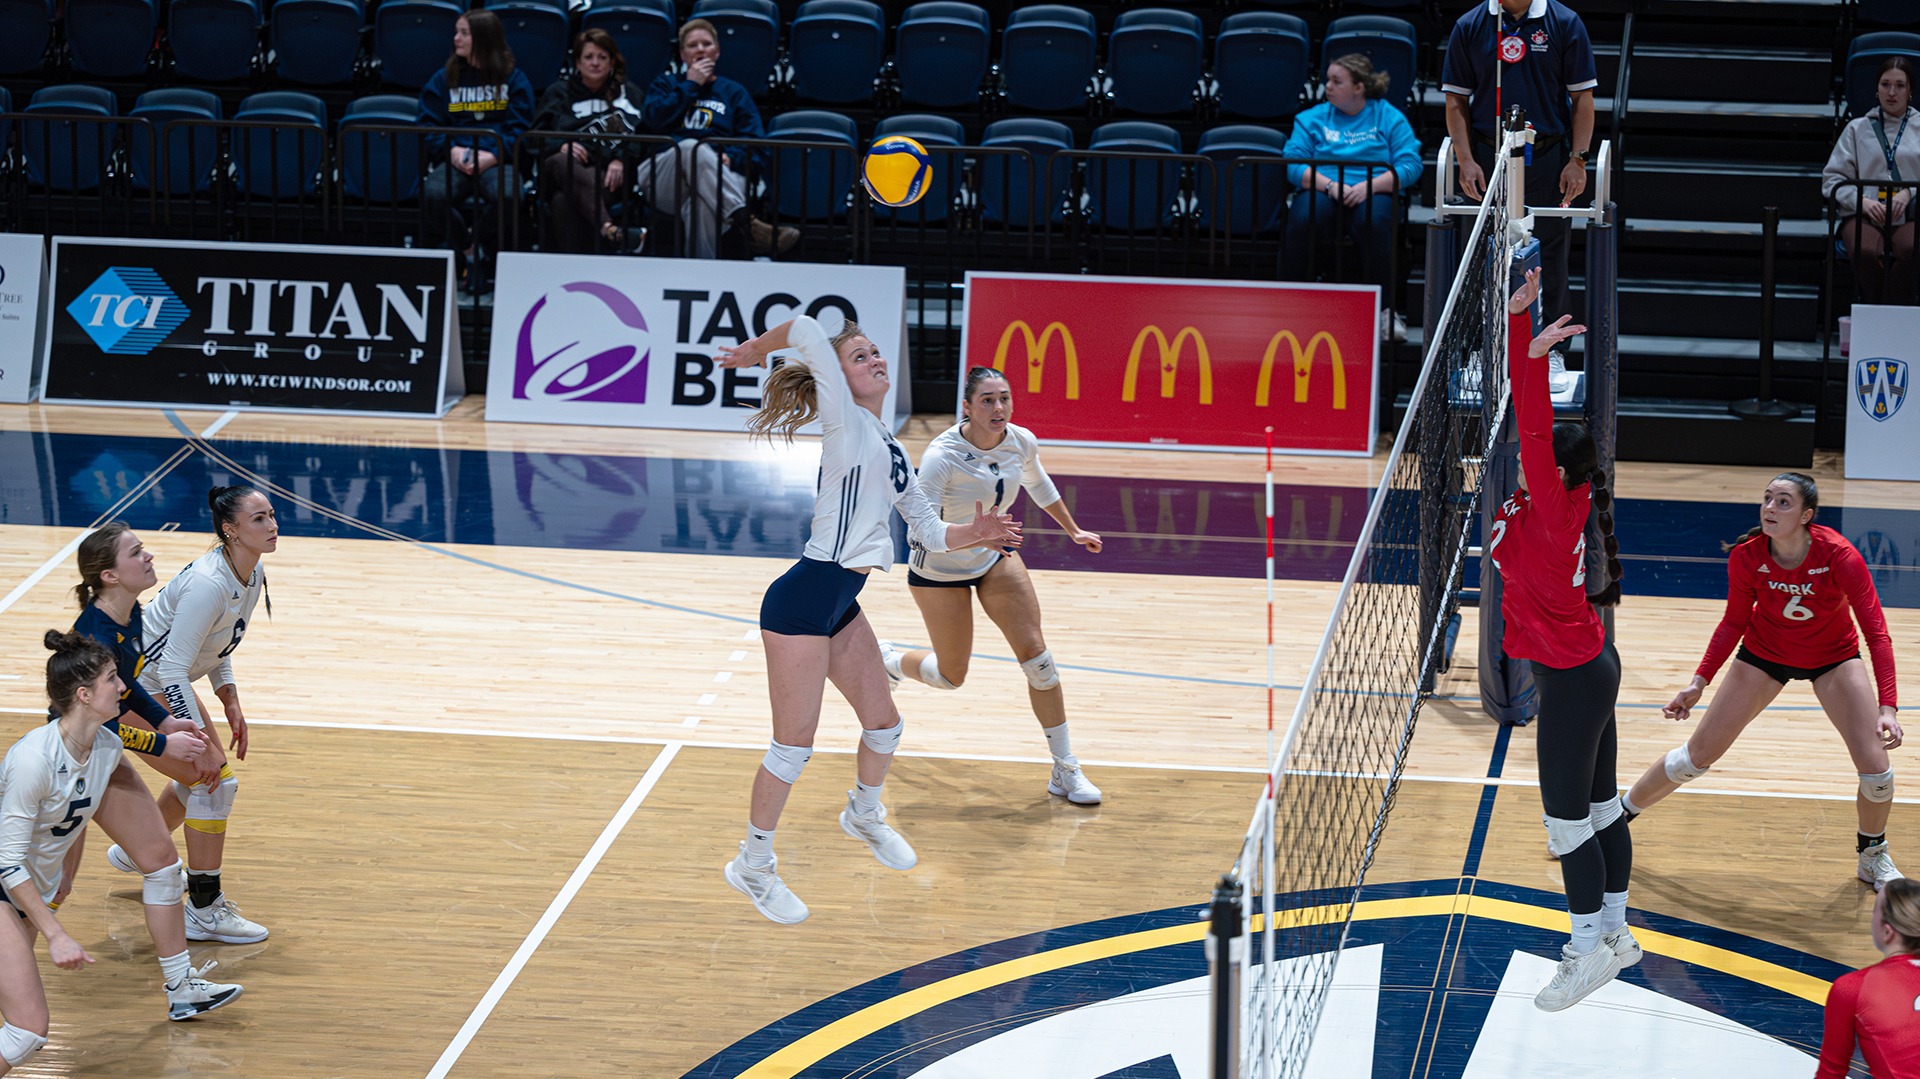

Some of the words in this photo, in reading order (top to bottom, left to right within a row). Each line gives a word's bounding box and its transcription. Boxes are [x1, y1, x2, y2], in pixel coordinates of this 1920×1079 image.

[449, 84, 508, 104] WINDSR
[87, 293, 168, 329] TCI
[197, 277, 436, 343] TITAN
[202, 340, 424, 365] GROUP
[207, 371, 412, 393] WWW.TCIWINDSOR.COM
[1767, 580, 1816, 596] YORK
[1782, 595, 1815, 621] 6
[217, 617, 246, 658] 6
[50, 796, 92, 837] 5
